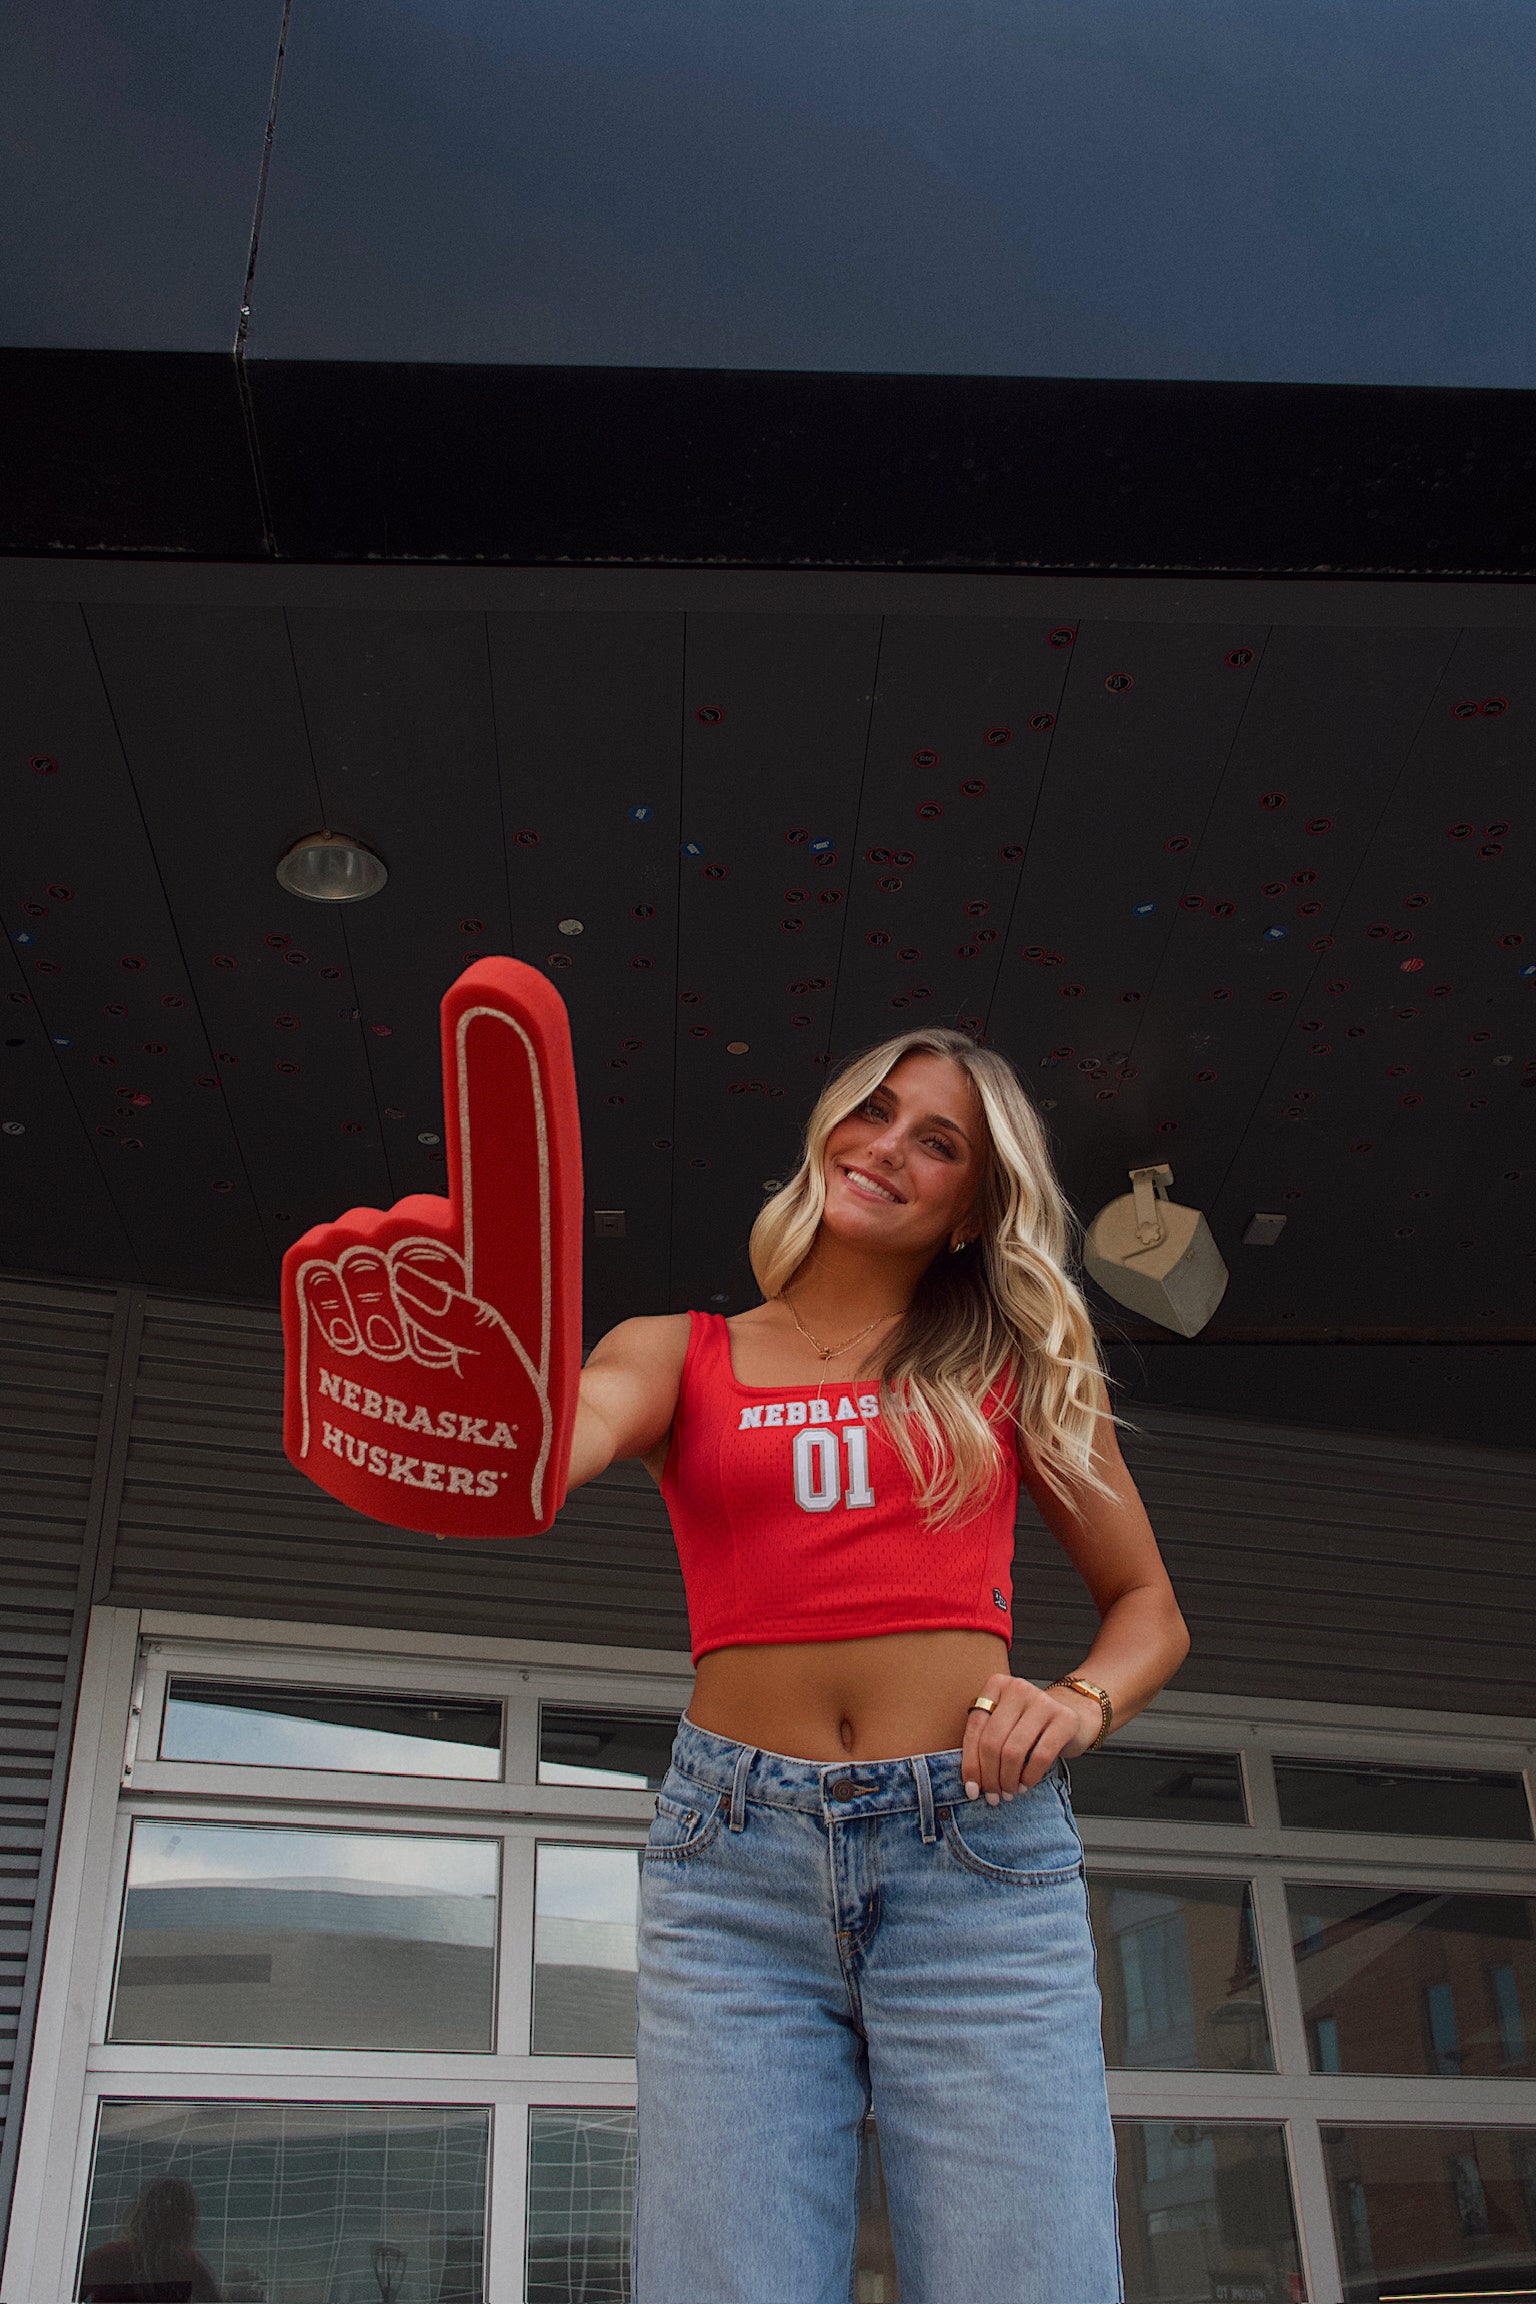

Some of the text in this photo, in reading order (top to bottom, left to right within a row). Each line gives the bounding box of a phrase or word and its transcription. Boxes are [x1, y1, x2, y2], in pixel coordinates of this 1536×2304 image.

[318, 1367, 518, 1450] NEBRASKA
[738, 1394, 881, 1431] NEBRAS
[321, 1420, 499, 1497] HUSKERS
[792, 1425, 876, 1513] 01
